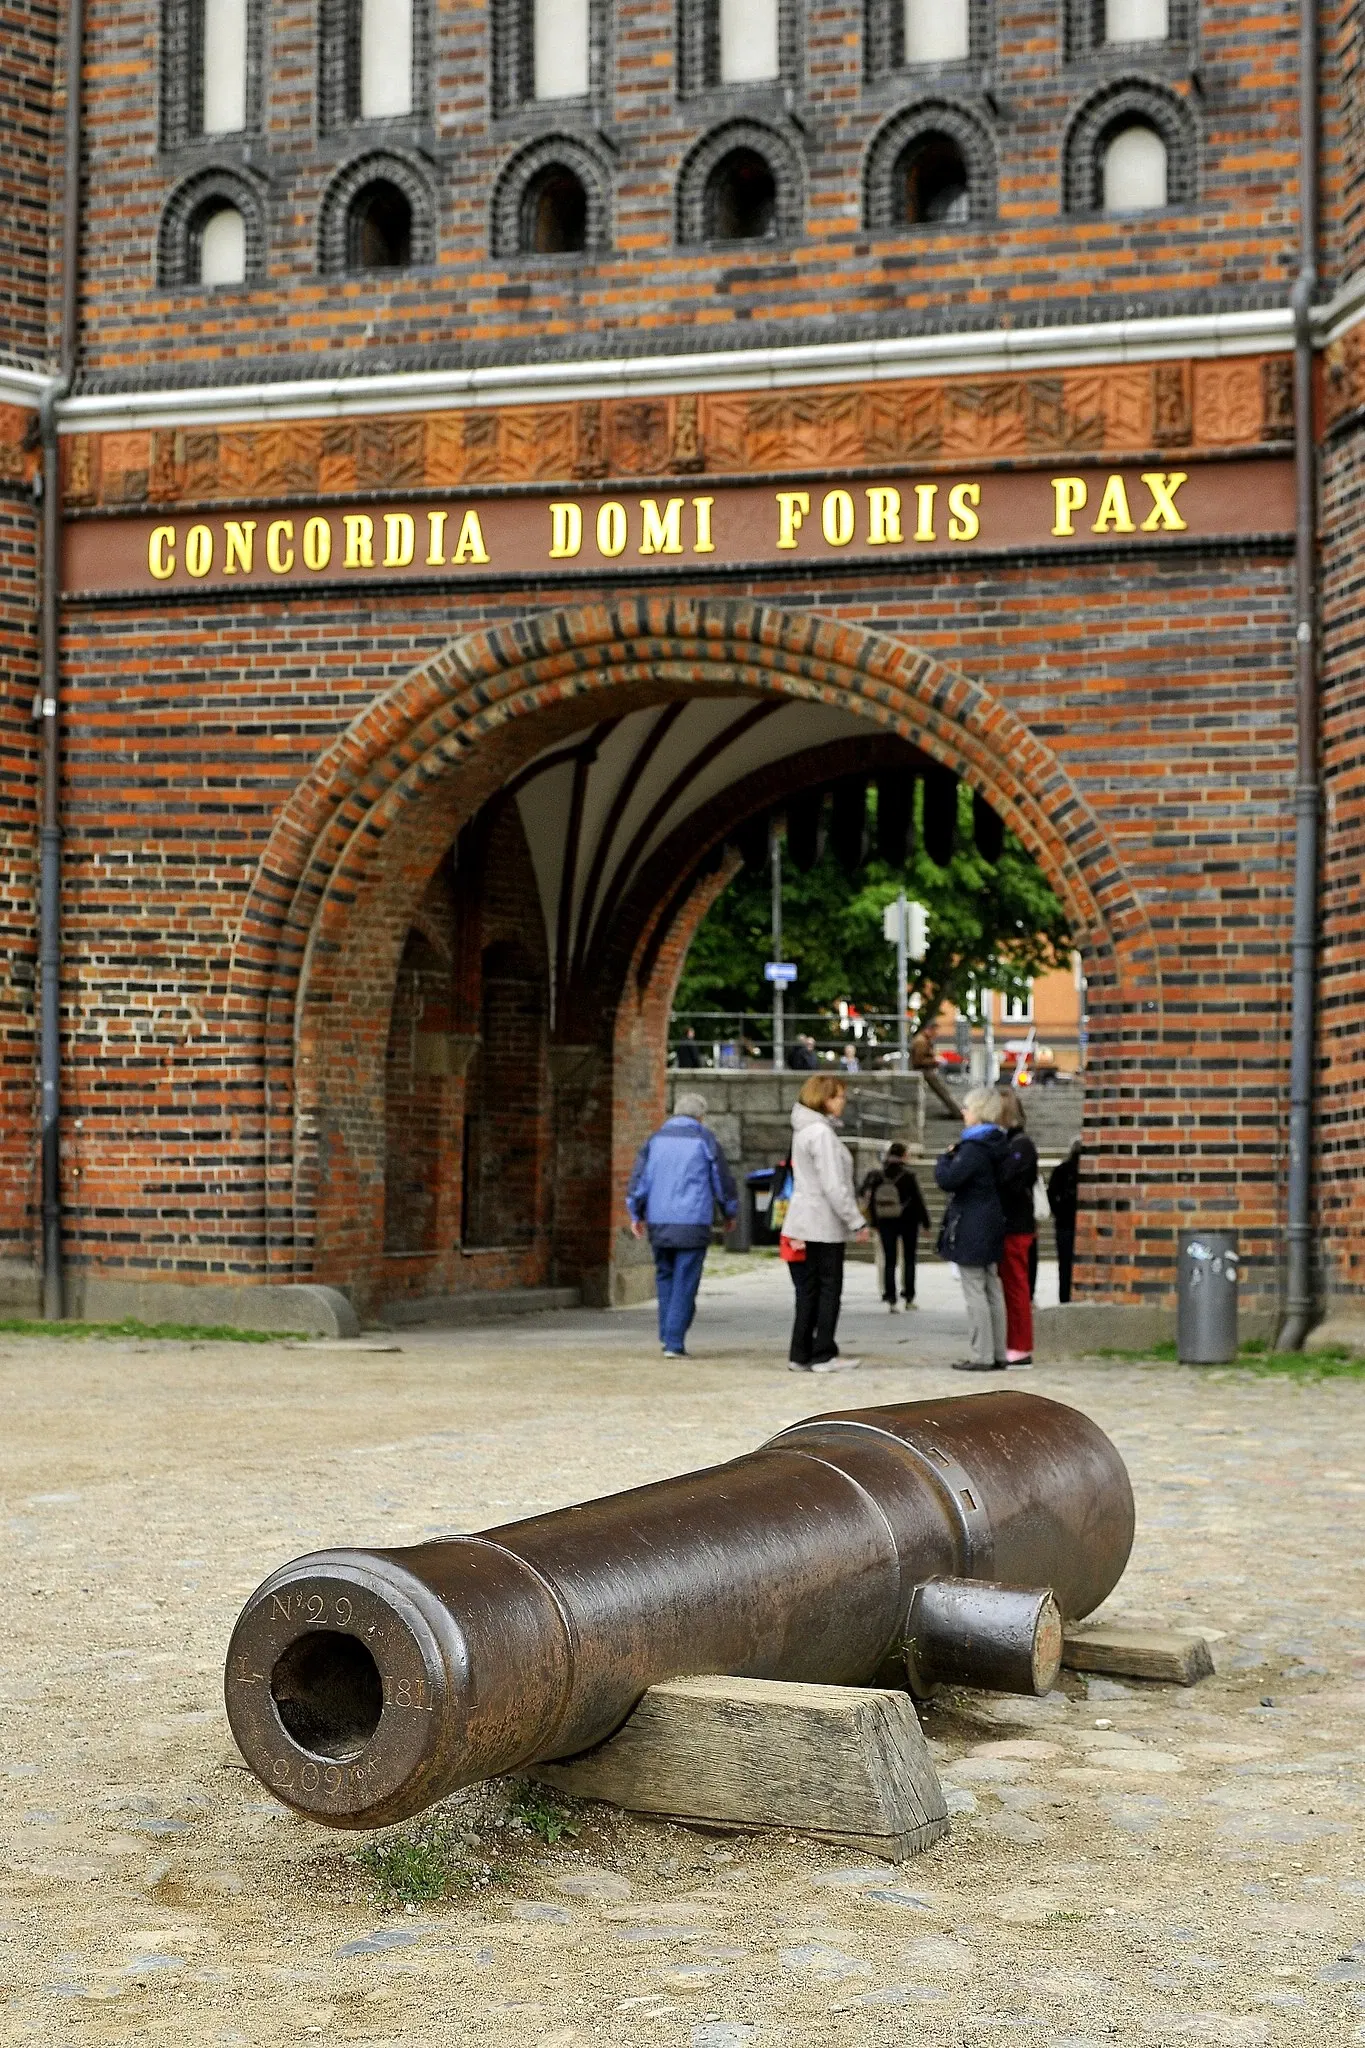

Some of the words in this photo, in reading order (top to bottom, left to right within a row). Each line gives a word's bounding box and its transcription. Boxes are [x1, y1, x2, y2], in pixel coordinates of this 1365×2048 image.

[148, 509, 491, 579] CONCORDIA
[548, 496, 716, 558] DOMI
[775, 483, 981, 549] FORIS
[1051, 472, 1188, 537] PAX
